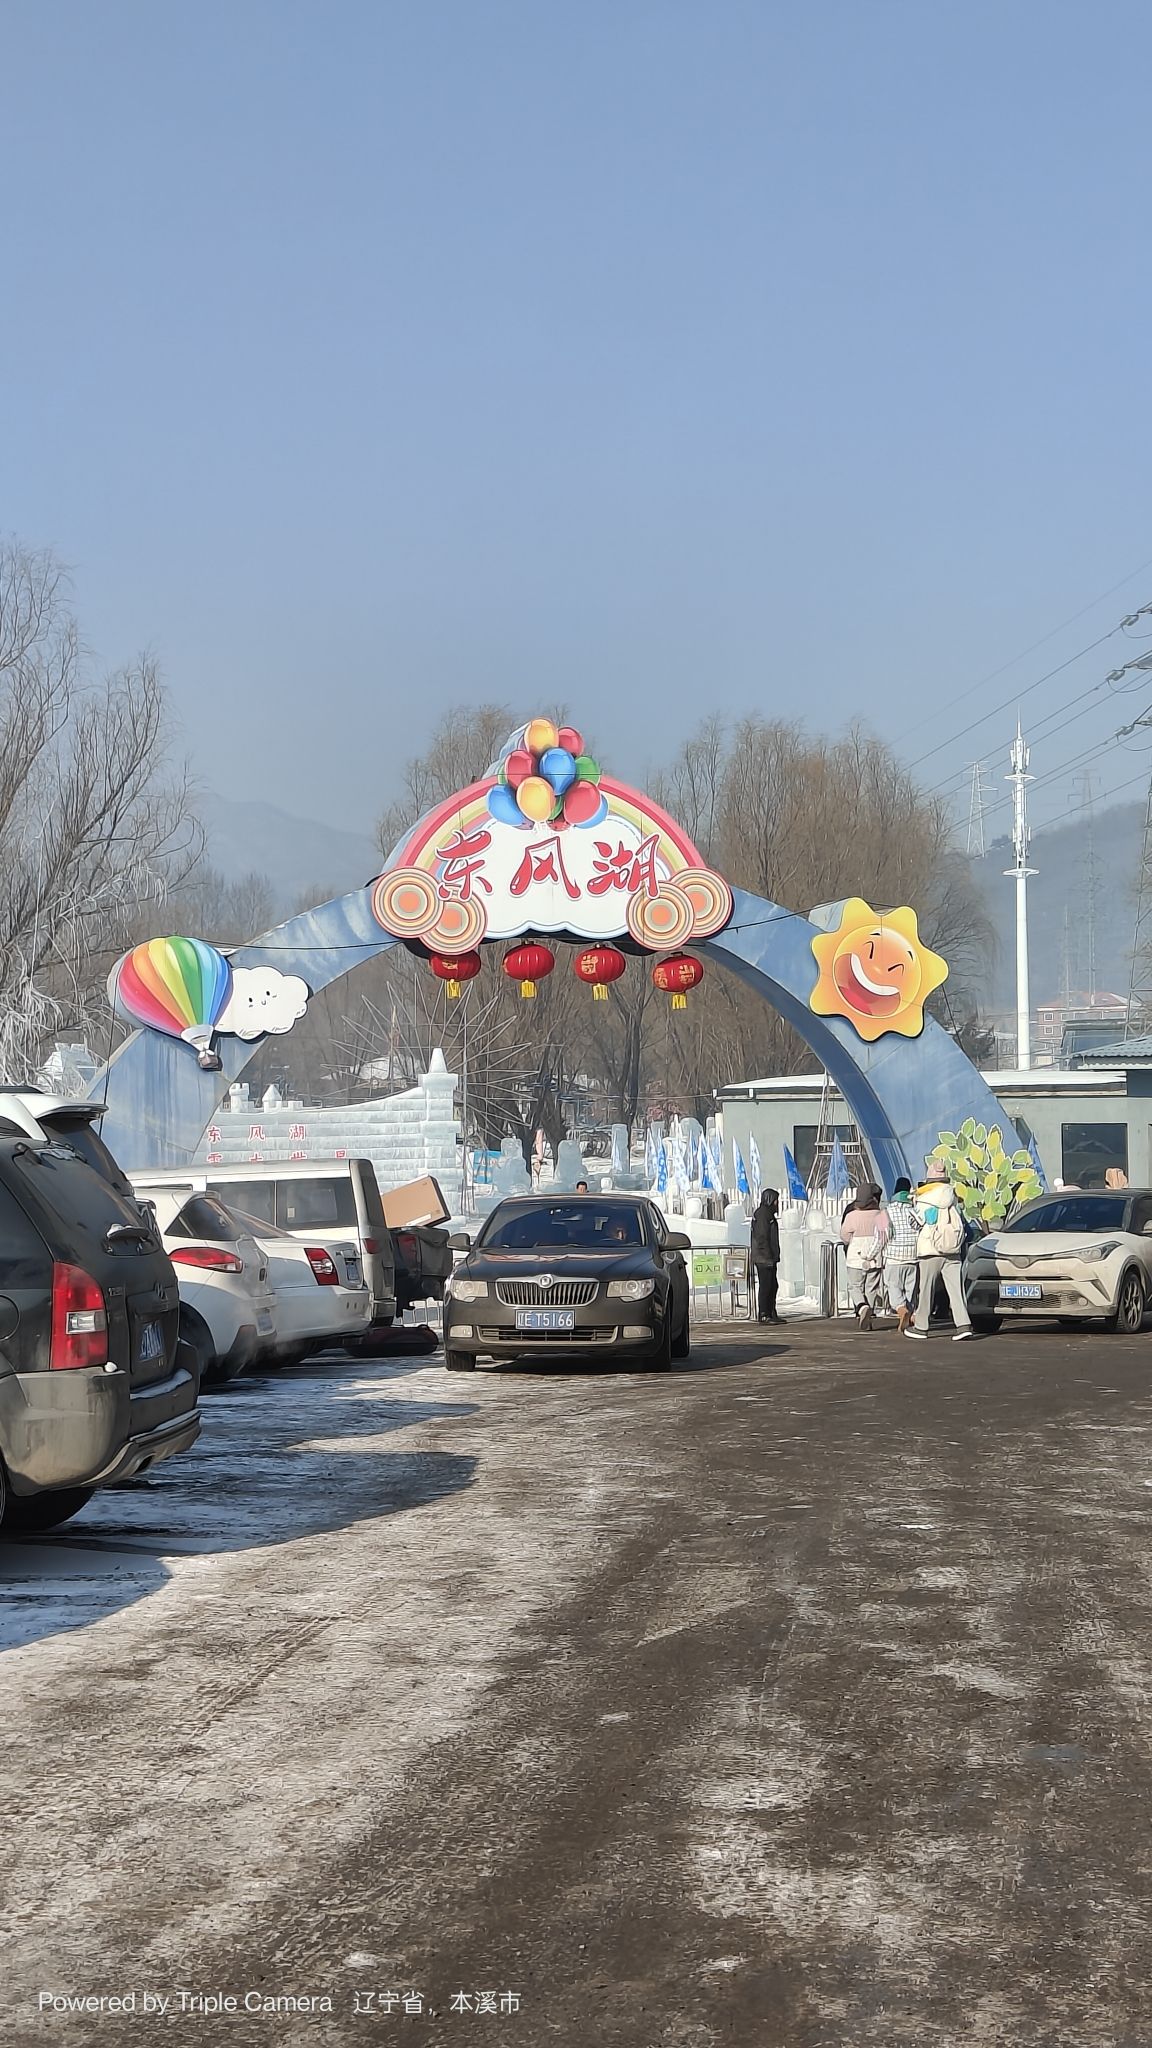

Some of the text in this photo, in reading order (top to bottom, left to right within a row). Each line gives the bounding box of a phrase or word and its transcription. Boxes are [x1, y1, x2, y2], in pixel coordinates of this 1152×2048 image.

[436, 830, 660, 900] 东风湖
[207, 1125, 306, 1143] 东风湖
